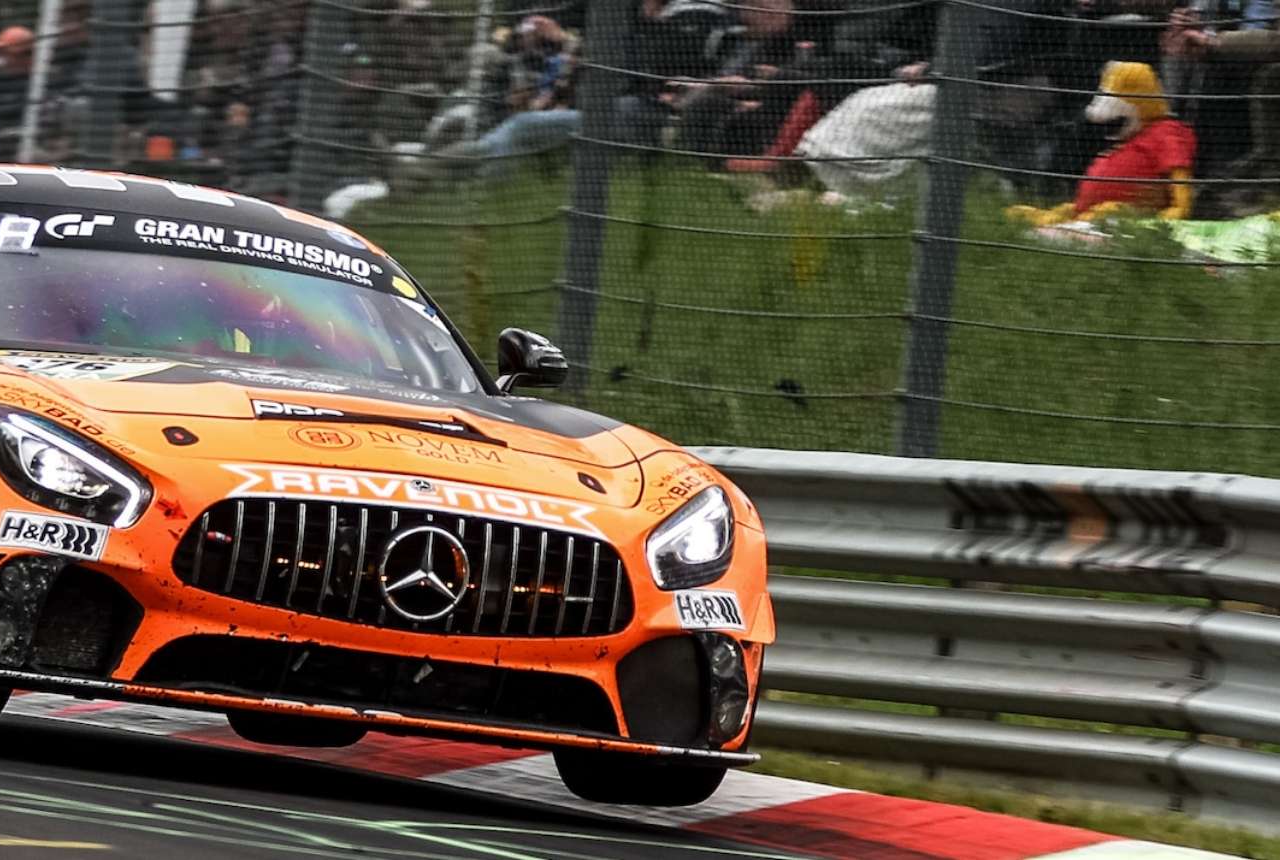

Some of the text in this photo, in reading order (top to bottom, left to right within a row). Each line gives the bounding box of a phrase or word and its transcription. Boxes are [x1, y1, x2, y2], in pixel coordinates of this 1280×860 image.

[134, 218, 225, 244] GRAN
[140, 235, 374, 287] THE REAL DRIVING SIMULATOR
[368, 430, 502, 463] NOVEM
[416, 449, 469, 464] GOLD
[269, 470, 573, 523] RAVENOL
[1, 517, 61, 544] H&R
[676, 595, 721, 620] H&R
